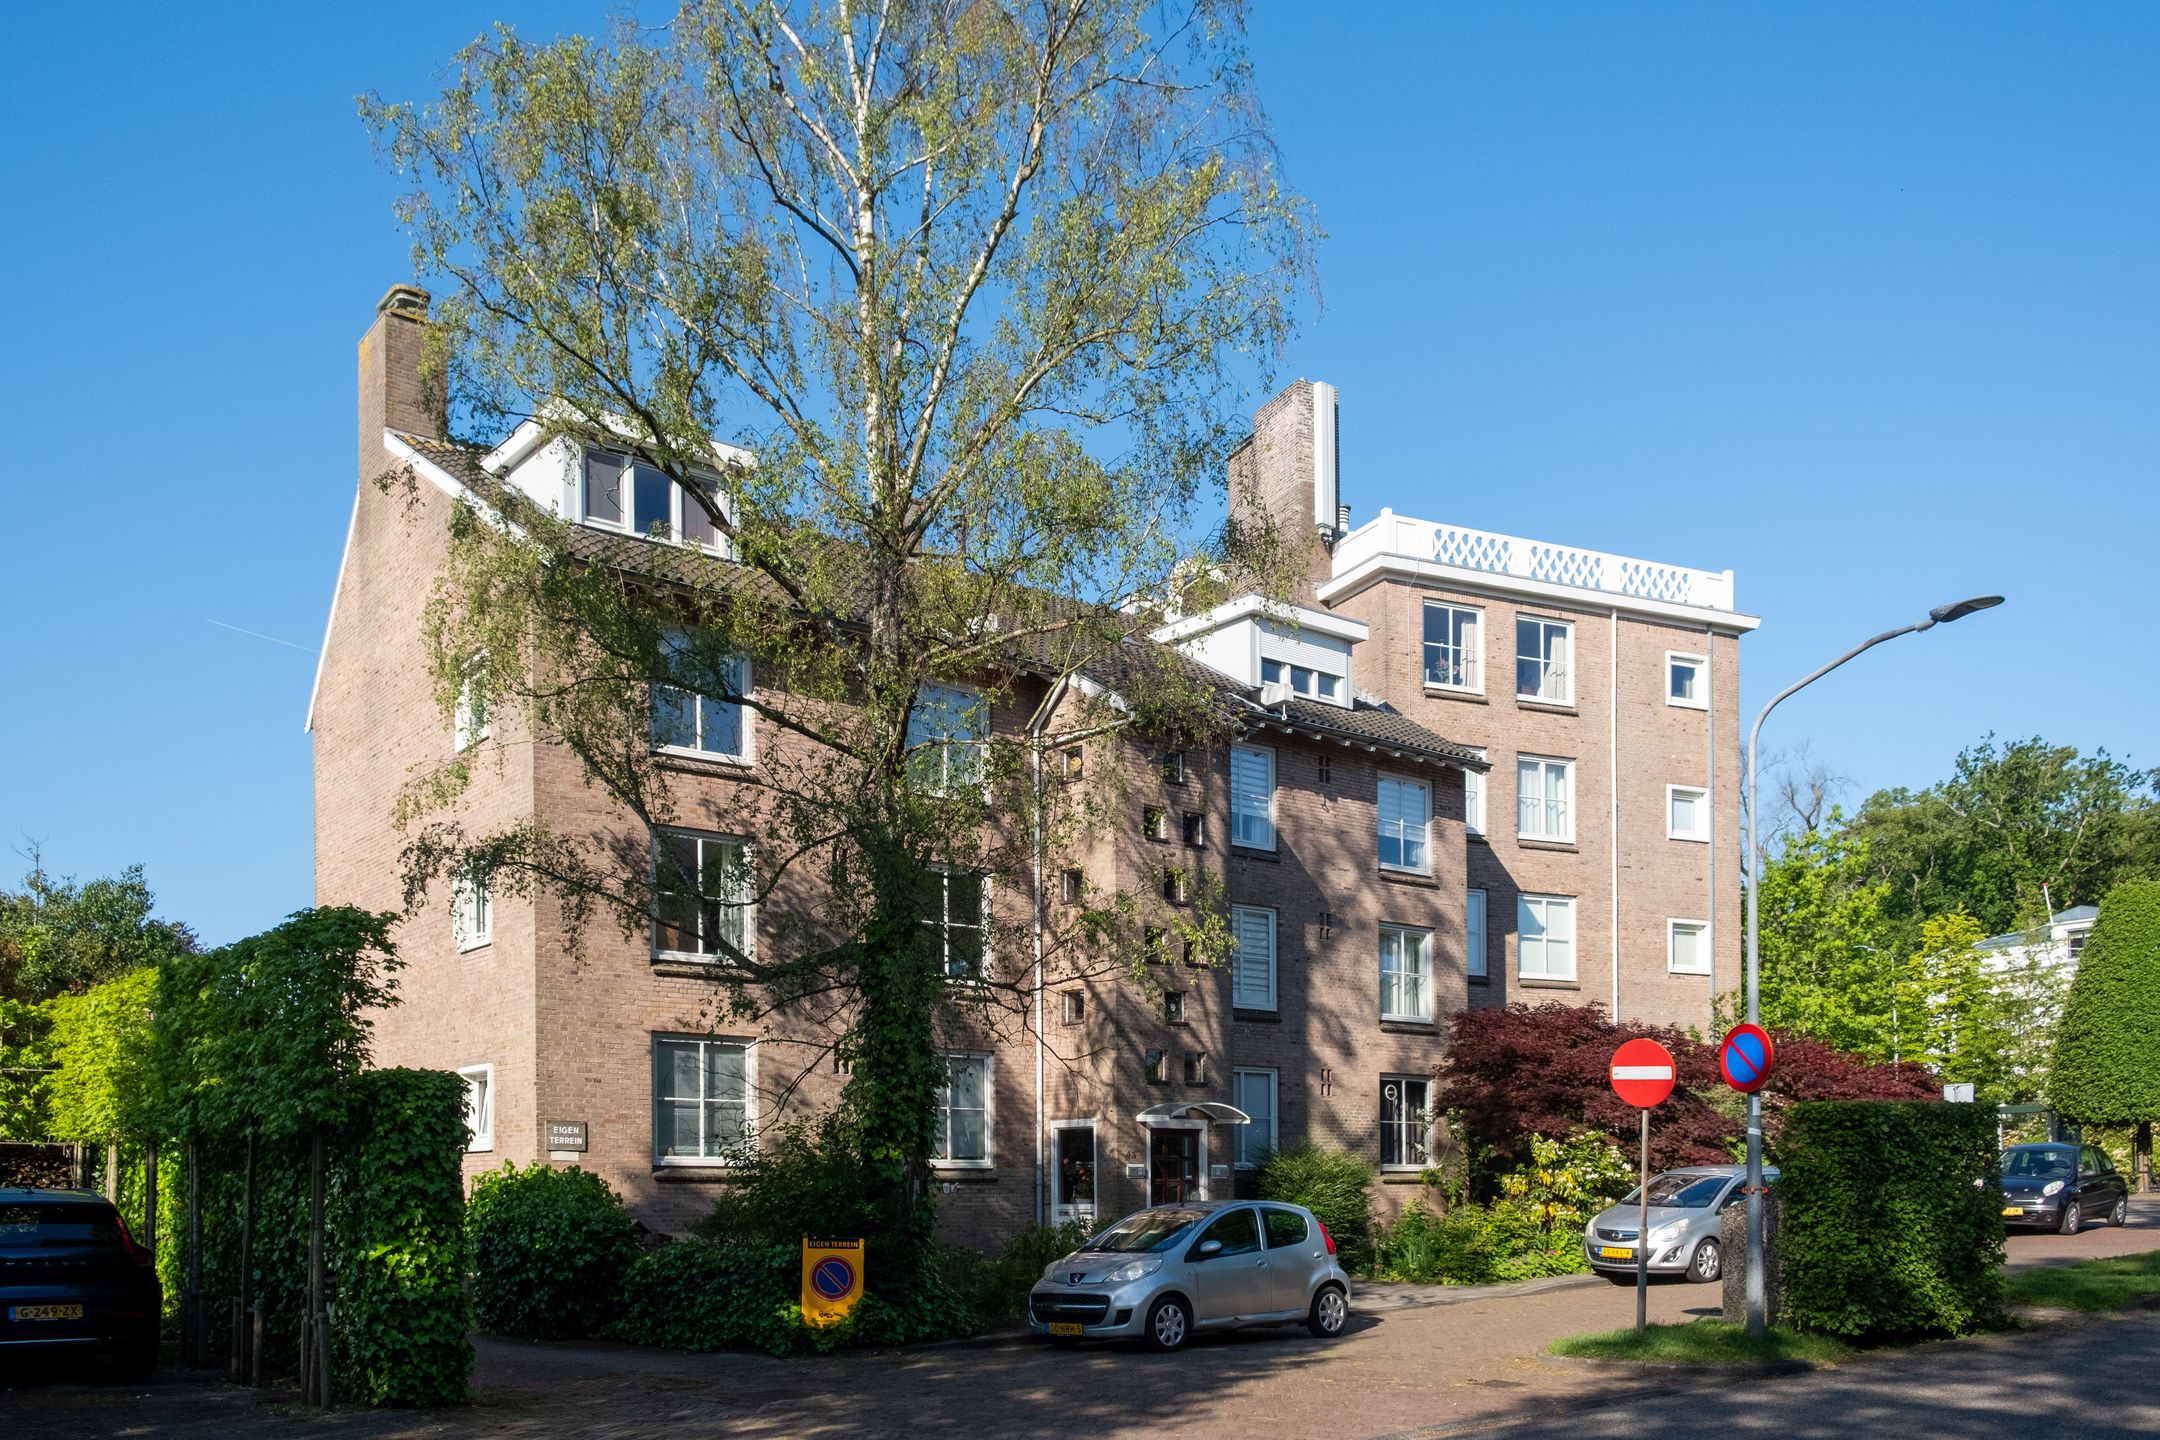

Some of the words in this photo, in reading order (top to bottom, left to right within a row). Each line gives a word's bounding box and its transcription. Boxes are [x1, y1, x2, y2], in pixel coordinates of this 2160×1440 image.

[553, 1126, 579, 1134] EIGEN
[549, 1136, 583, 1145] TERREIN
[809, 1240, 830, 1248] EIGEN
[831, 1240, 859, 1248] TERREIN
[20, 1306, 78, 1318] G-249-ZX
